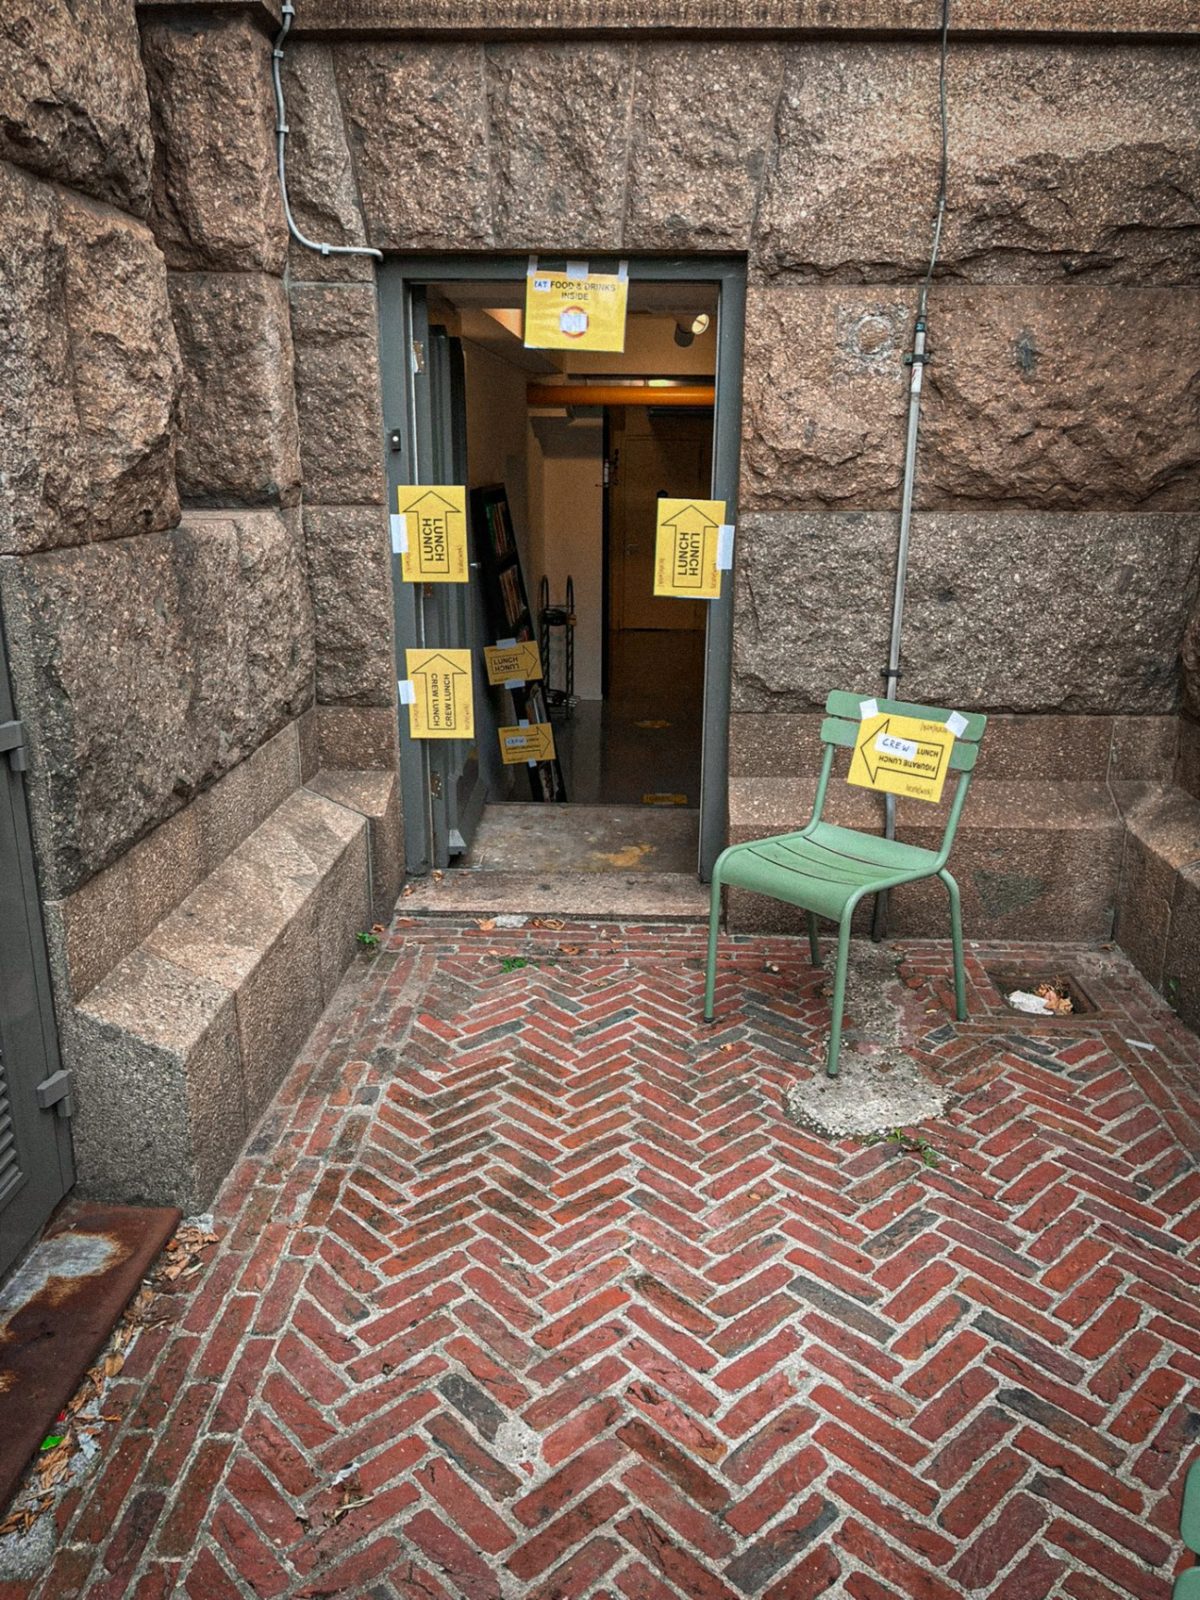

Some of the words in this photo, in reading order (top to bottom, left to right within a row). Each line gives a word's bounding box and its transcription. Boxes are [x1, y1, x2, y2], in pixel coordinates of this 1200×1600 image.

[550, 281, 575, 289] FOOD
[584, 282, 616, 292] DRINKS
[561, 292, 589, 300] INSIDE
[422, 518, 434, 561] LUNCH
[433, 518, 445, 562] LUNCH
[677, 532, 689, 576] LUNCH
[688, 533, 700, 576] LUNCH
[493, 656, 519, 665] LUNCH
[494, 663, 520, 672] LUNCH
[431, 673, 439, 697] CREW
[444, 673, 452, 701] LUNCH
[432, 699, 440, 727] LUNCH
[444, 703, 453, 727] CREW
[882, 738, 910, 752] CREW
[917, 748, 939, 757] LUNCH
[879, 755, 901, 766] LUNCH
[903, 760, 936, 772] FIGURATIE
